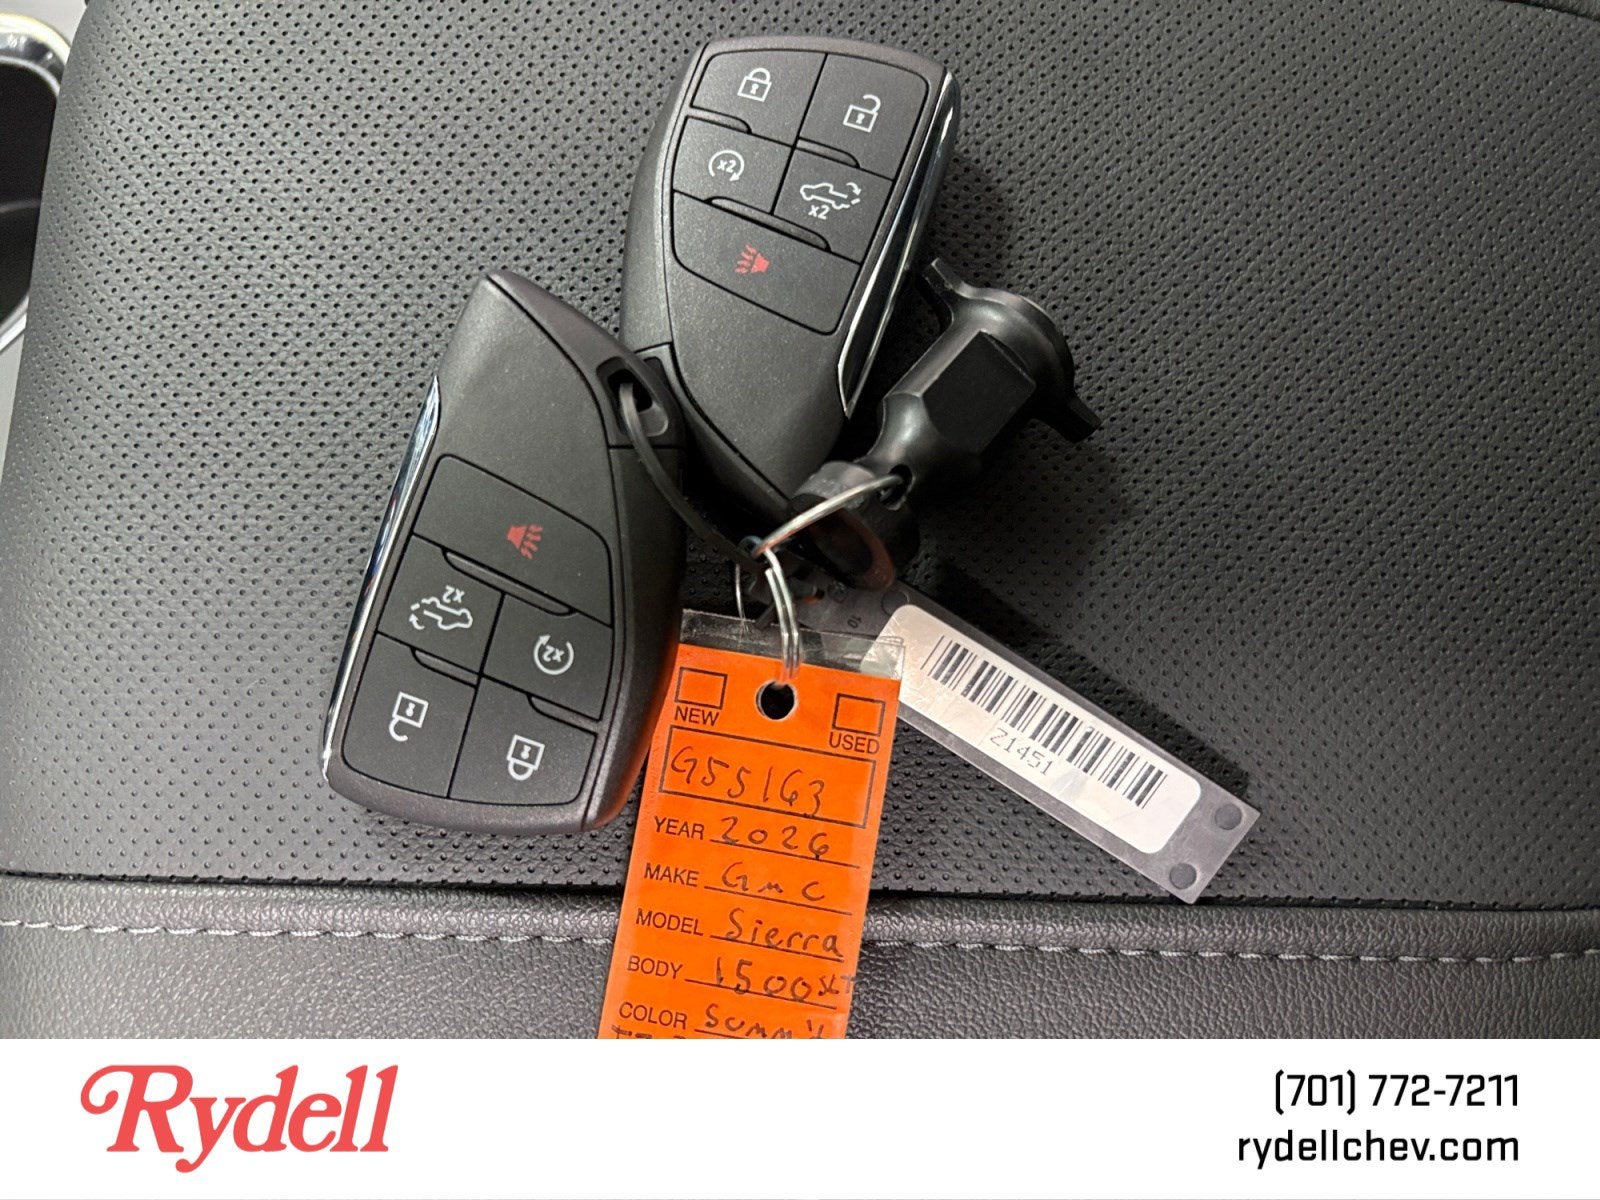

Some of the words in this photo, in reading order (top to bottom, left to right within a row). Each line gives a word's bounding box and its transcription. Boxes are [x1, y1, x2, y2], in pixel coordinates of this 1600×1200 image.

[716, 159, 737, 173] x2
[808, 203, 830, 220] x2
[443, 585, 465, 603] x2
[542, 645, 565, 663] x2
[674, 705, 720, 727] NEW
[828, 732, 880, 755] USED
[990, 727, 1053, 776] Z1451
[654, 816, 705, 840] YEAR
[720, 816, 830, 860] 2026
[643, 863, 700, 888] MAKE
[635, 908, 704, 937] MODEL
[725, 908, 843, 958] Sierra
[626, 955, 683, 980] BODY
[618, 1001, 688, 1030] COLOR
